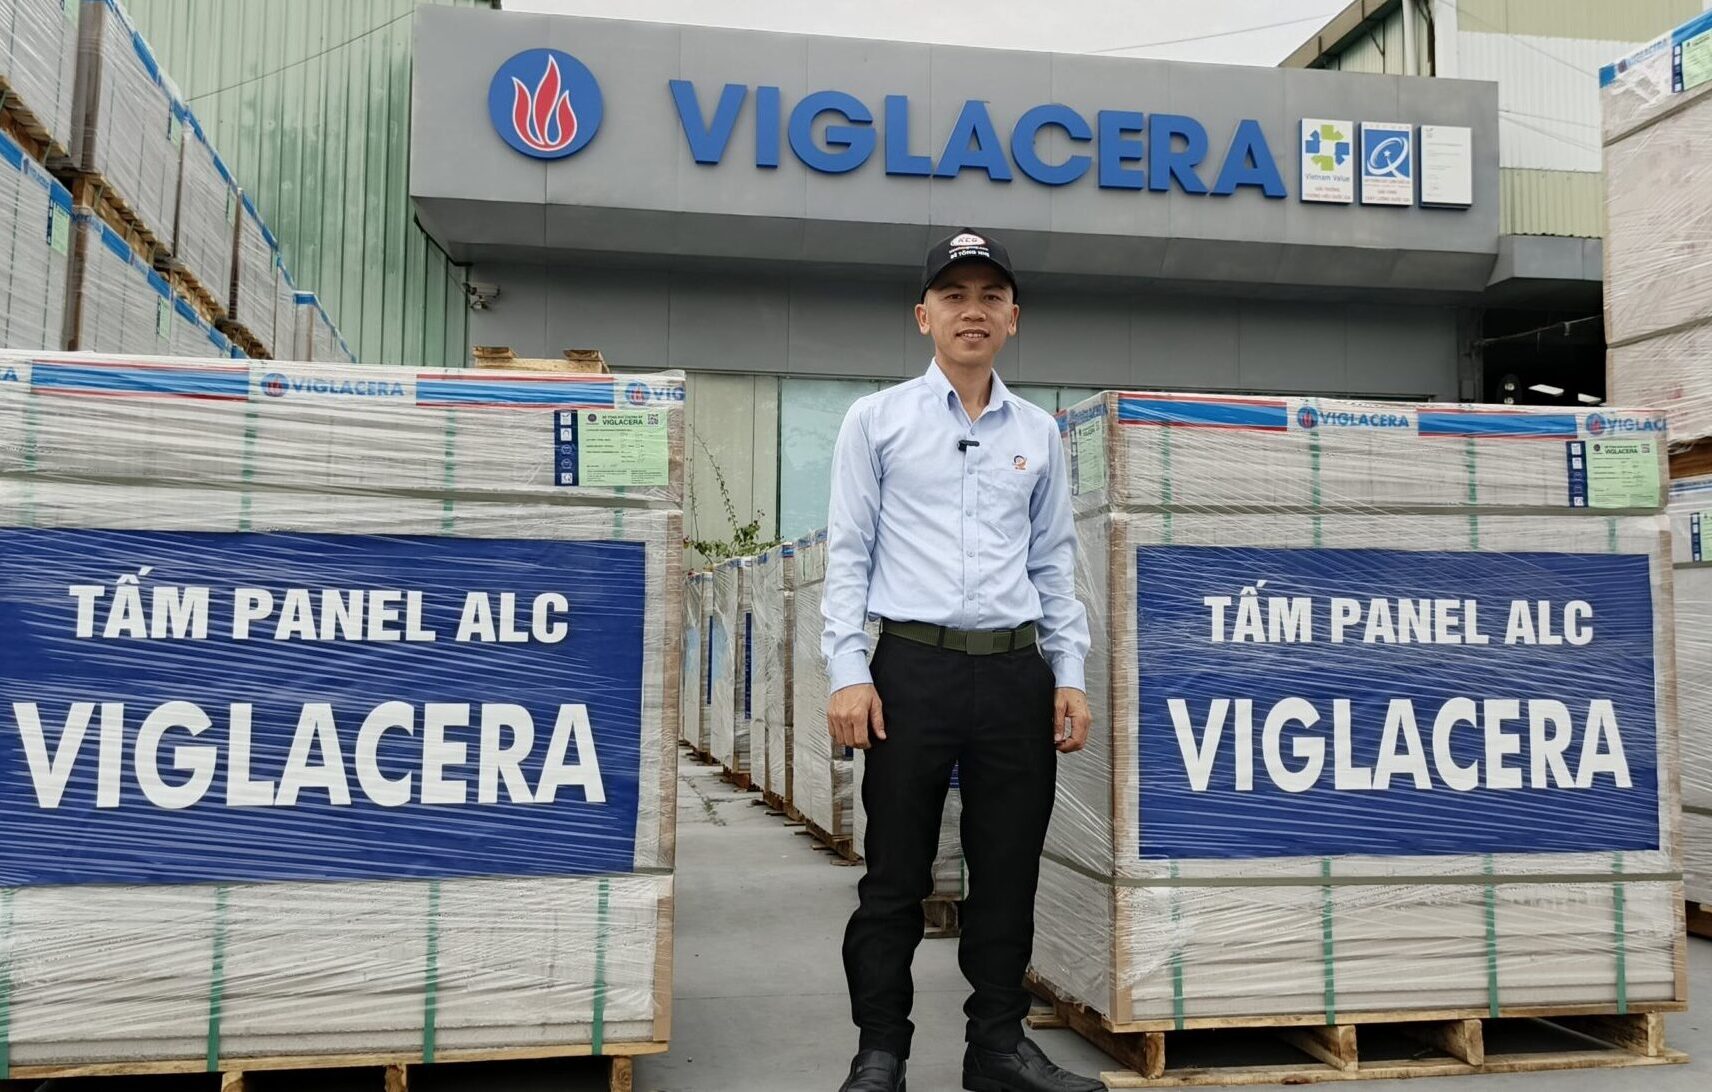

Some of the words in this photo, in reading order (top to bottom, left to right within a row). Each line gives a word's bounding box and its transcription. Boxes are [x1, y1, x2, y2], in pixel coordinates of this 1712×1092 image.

[669, 80, 1288, 199] VIGLACERA
[1305, 173, 1331, 182] Vietnam
[1333, 174, 1350, 183] Value
[292, 377, 405, 396] VIGLACERA
[1320, 411, 1410, 427] VIGLACERA
[69, 566, 209, 639] TẤM
[232, 588, 438, 642] PANEL
[454, 590, 569, 644] ALC
[1204, 578, 1313, 644] TẤM
[1330, 597, 1489, 645] PANEL
[1504, 599, 1594, 646] ALC
[13, 701, 607, 809] VIGLACERA
[1167, 696, 1633, 793] VIGLACERA
